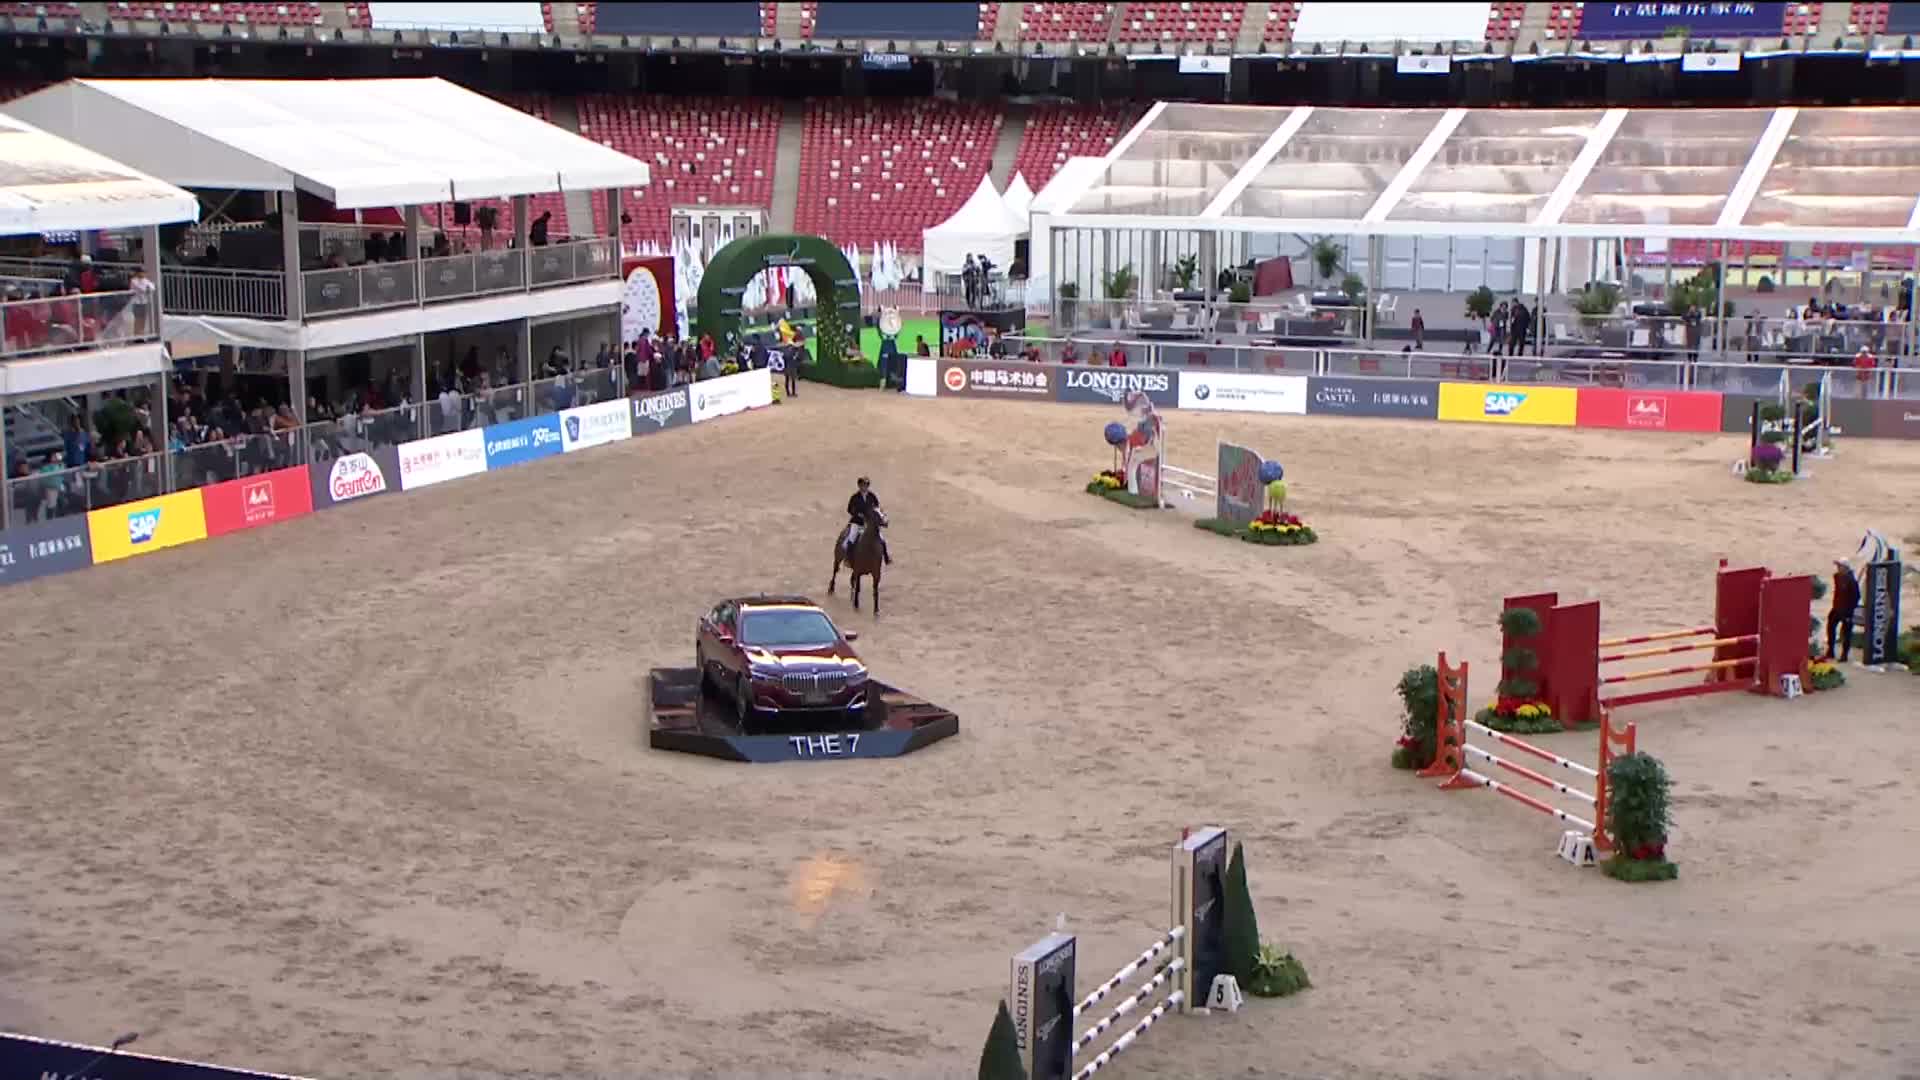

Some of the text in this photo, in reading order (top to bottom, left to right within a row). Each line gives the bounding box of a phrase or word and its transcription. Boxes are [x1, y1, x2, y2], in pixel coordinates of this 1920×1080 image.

[970, 369, 1047, 386] 中国马术协会
[1066, 370, 1169, 391] LONGINES
[634, 390, 687, 417] LONGINES
[1315, 392, 1358, 404] CASTEL
[1485, 395, 1518, 412] SAP
[129, 514, 156, 539] SAP
[1873, 567, 1888, 660] LONGINES
[788, 733, 860, 756] THE 7
[1216, 983, 1224, 1004] 5
[1016, 965, 1029, 1050] LONGINES
